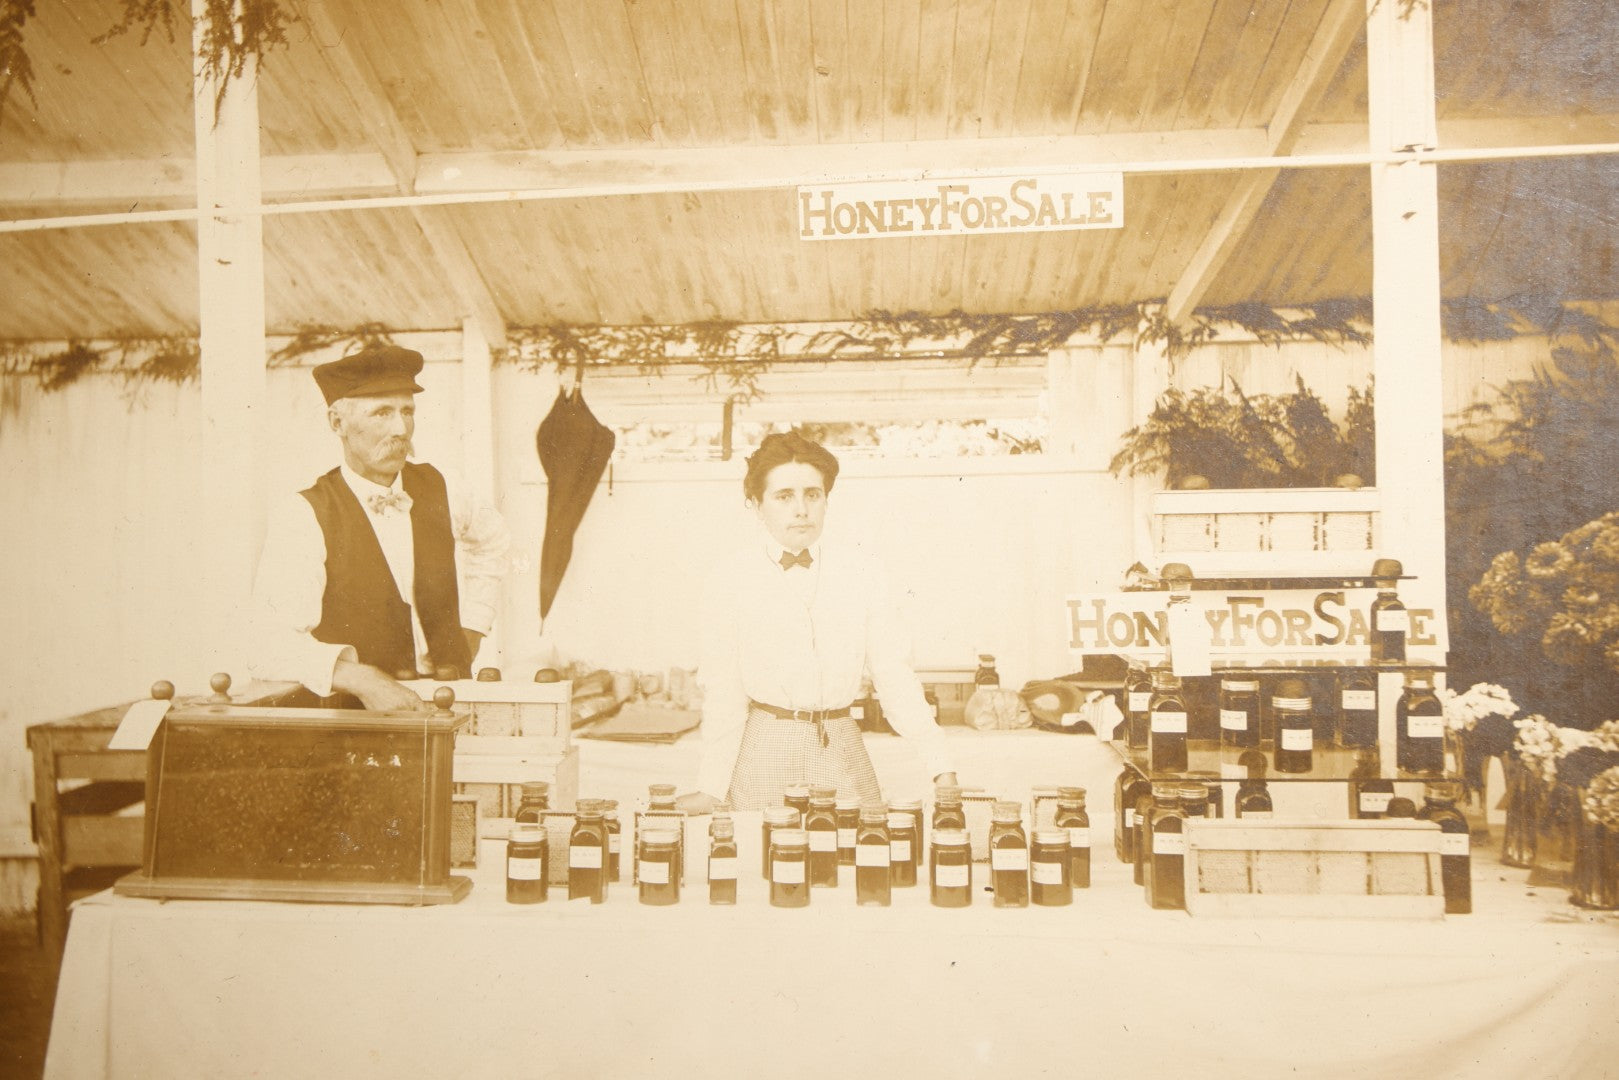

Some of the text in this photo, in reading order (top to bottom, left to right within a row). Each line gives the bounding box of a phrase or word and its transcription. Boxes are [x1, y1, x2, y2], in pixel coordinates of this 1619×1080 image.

[800, 179, 1112, 236] HONEY FOR SALE
[1067, 599, 1229, 648] HONY
[1314, 592, 1437, 646] SAE
